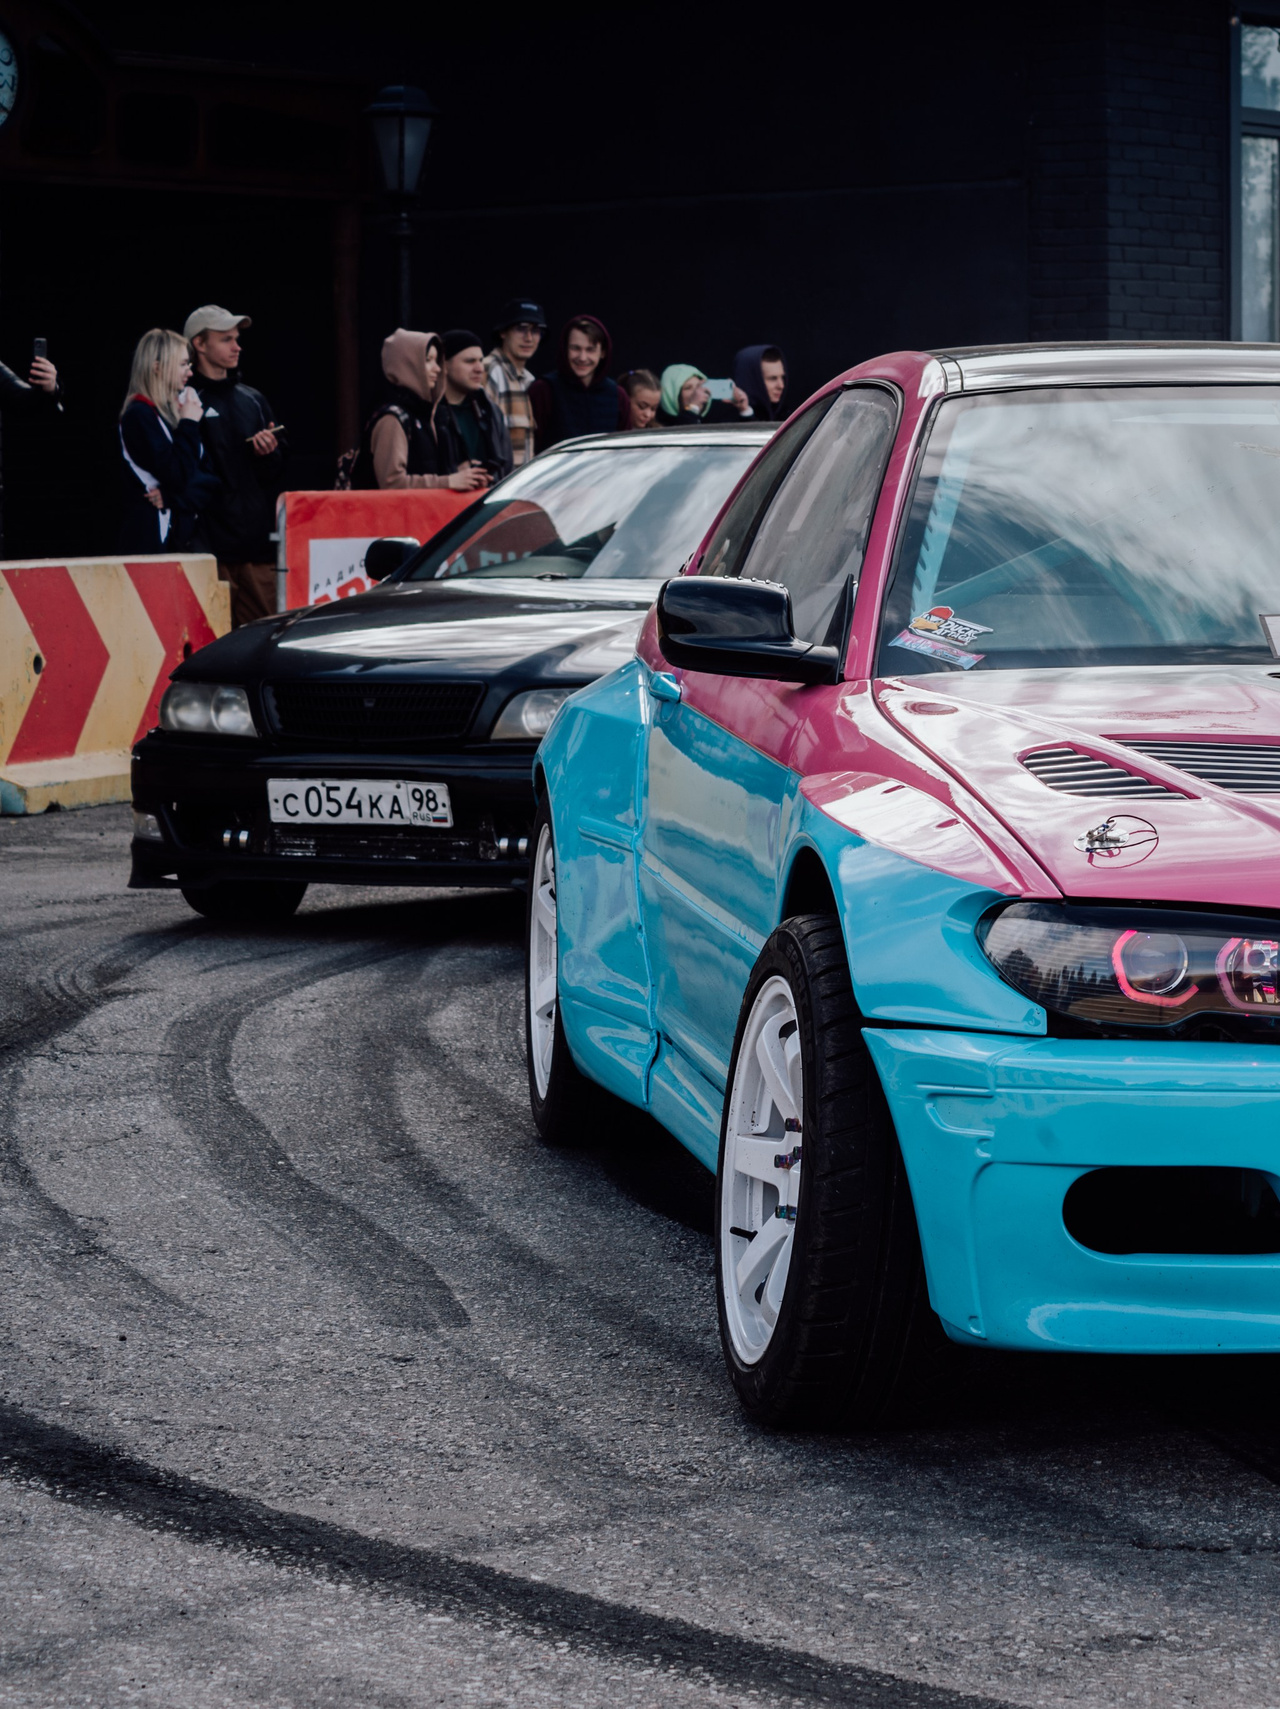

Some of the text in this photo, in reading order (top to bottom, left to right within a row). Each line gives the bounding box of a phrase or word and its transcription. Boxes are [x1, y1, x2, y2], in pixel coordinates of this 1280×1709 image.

[411, 788, 439, 812] 98
[412, 811, 431, 822] RUS
[785, 943, 809, 1007] SPORT
